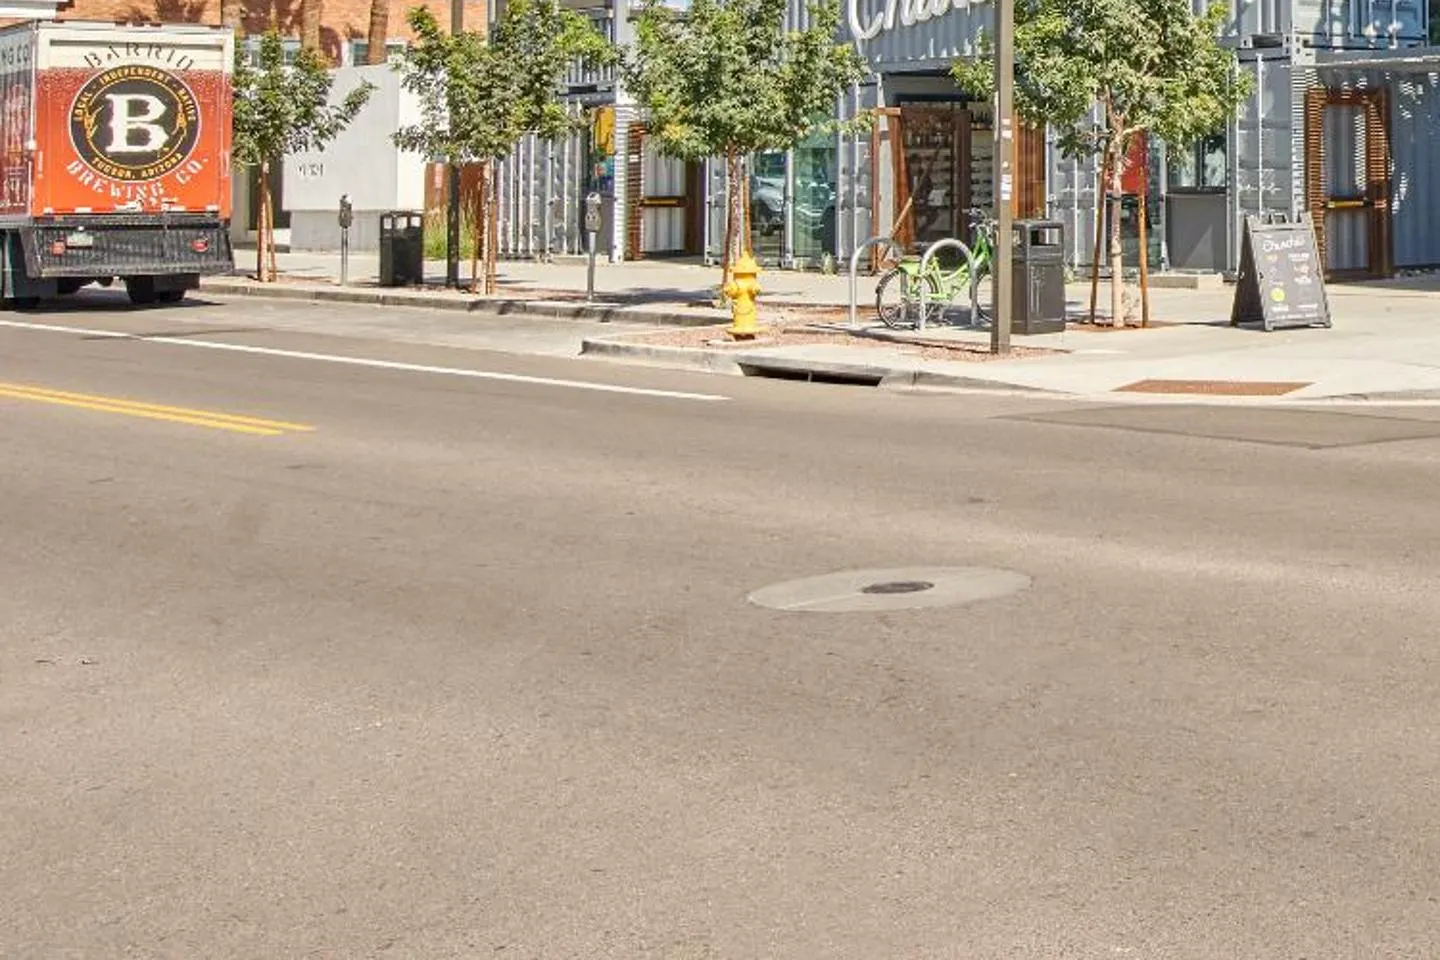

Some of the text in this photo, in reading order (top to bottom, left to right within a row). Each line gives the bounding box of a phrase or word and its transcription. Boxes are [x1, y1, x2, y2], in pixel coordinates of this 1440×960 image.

[84, 42, 194, 71] BARRIO
[105, 93, 169, 153] B
[66, 159, 164, 197] BREWING
